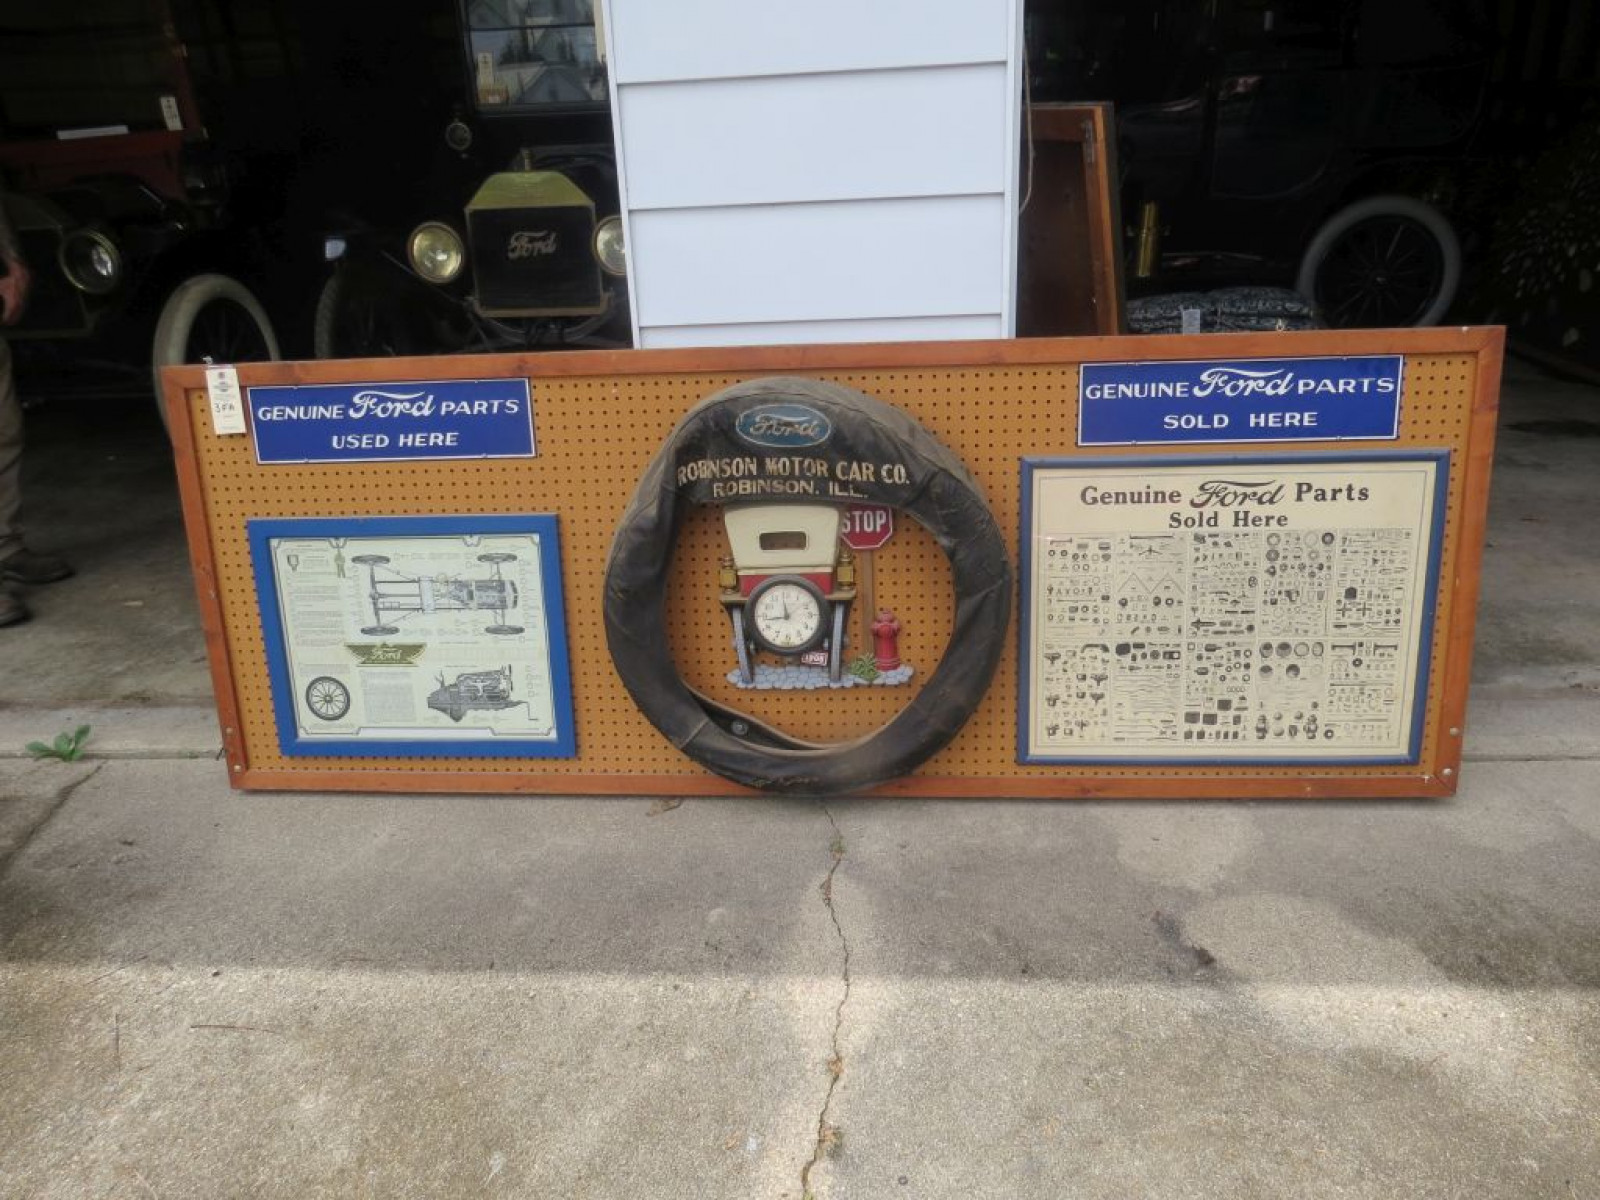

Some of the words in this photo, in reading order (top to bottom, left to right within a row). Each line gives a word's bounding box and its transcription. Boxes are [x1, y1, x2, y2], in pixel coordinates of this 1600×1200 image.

[508, 231, 556, 259] Ford
[1085, 382, 1190, 400] GENUINE
[1193, 367, 1295, 398] Ford
[1298, 377, 1395, 395] PARTS
[257, 404, 344, 421] GENUINE
[349, 391, 436, 419] Ford
[441, 399, 519, 415] PARTS
[749, 413, 821, 439] Ford
[1163, 413, 1230, 430] SOLD
[1249, 411, 1319, 428] HERE
[331, 434, 390, 449] USED
[398, 431, 460, 448] HERE
[765, 457, 829, 478] MOTOR
[836, 461, 875, 483] CAR
[881, 464, 911, 485] CO.
[1080, 485, 1182, 506] Genuine
[1189, 479, 1286, 509] Ford
[1295, 482, 1370, 503] Parts
[841, 510, 887, 534] STOP
[1168, 511, 1219, 530] Sold
[1232, 510, 1288, 529] Here
